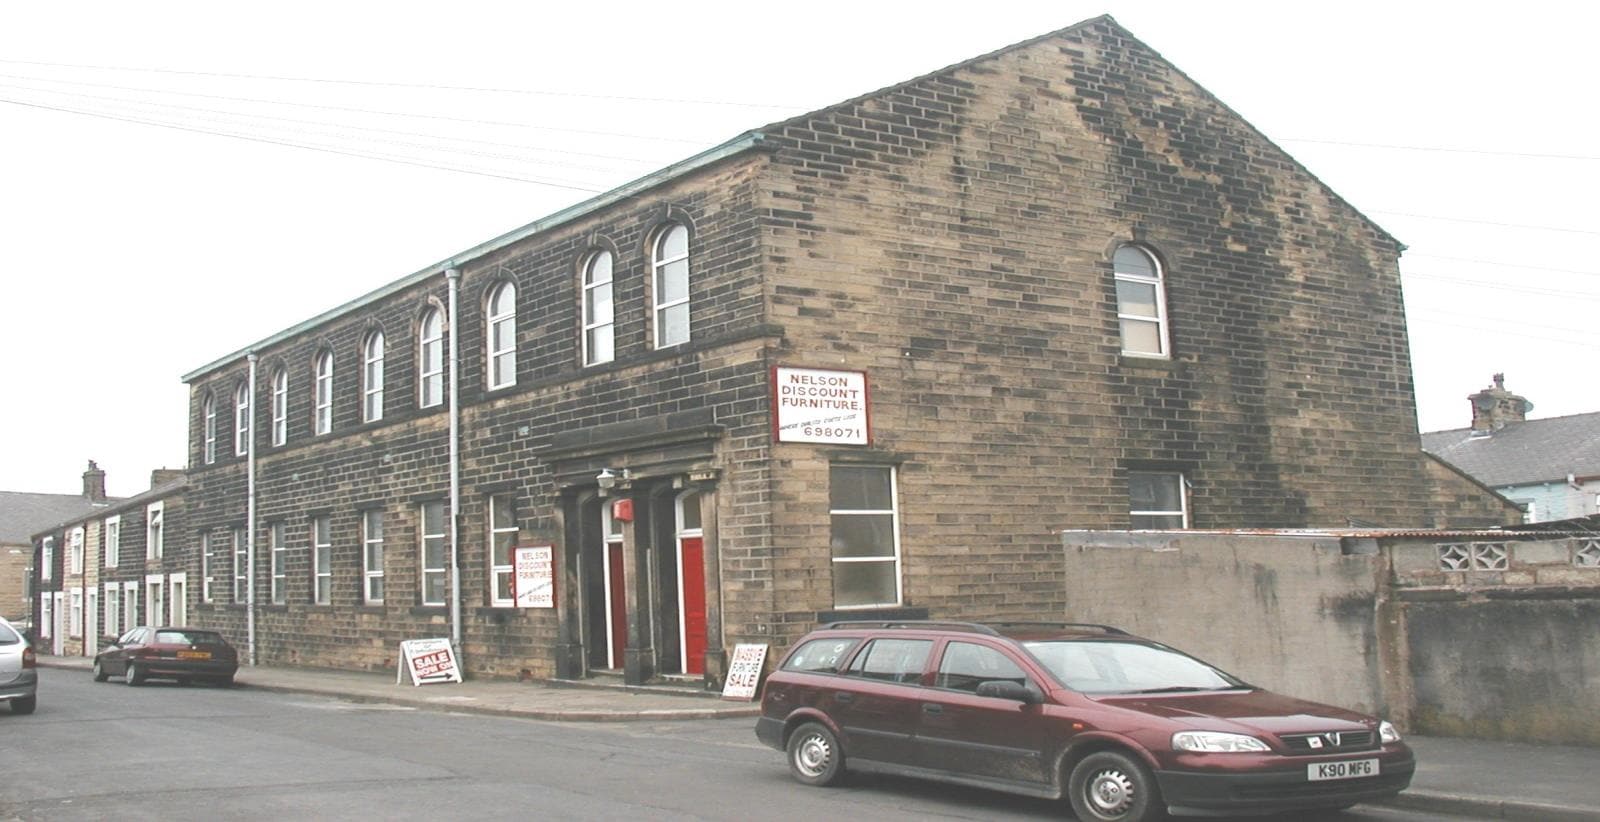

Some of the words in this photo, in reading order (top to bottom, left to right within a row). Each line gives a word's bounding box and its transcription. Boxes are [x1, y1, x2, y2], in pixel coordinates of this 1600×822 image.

[790, 374, 848, 387] NELSON
[782, 385, 859, 399] DISCOUNT
[782, 397, 862, 410] FURNITURE.
[804, 427, 860, 438] 698071
[522, 552, 548, 560] NELSON
[414, 651, 449, 669] SALE
[728, 673, 756, 687] SALE
[1318, 763, 1346, 778] K90
[1348, 761, 1372, 775] MFG
